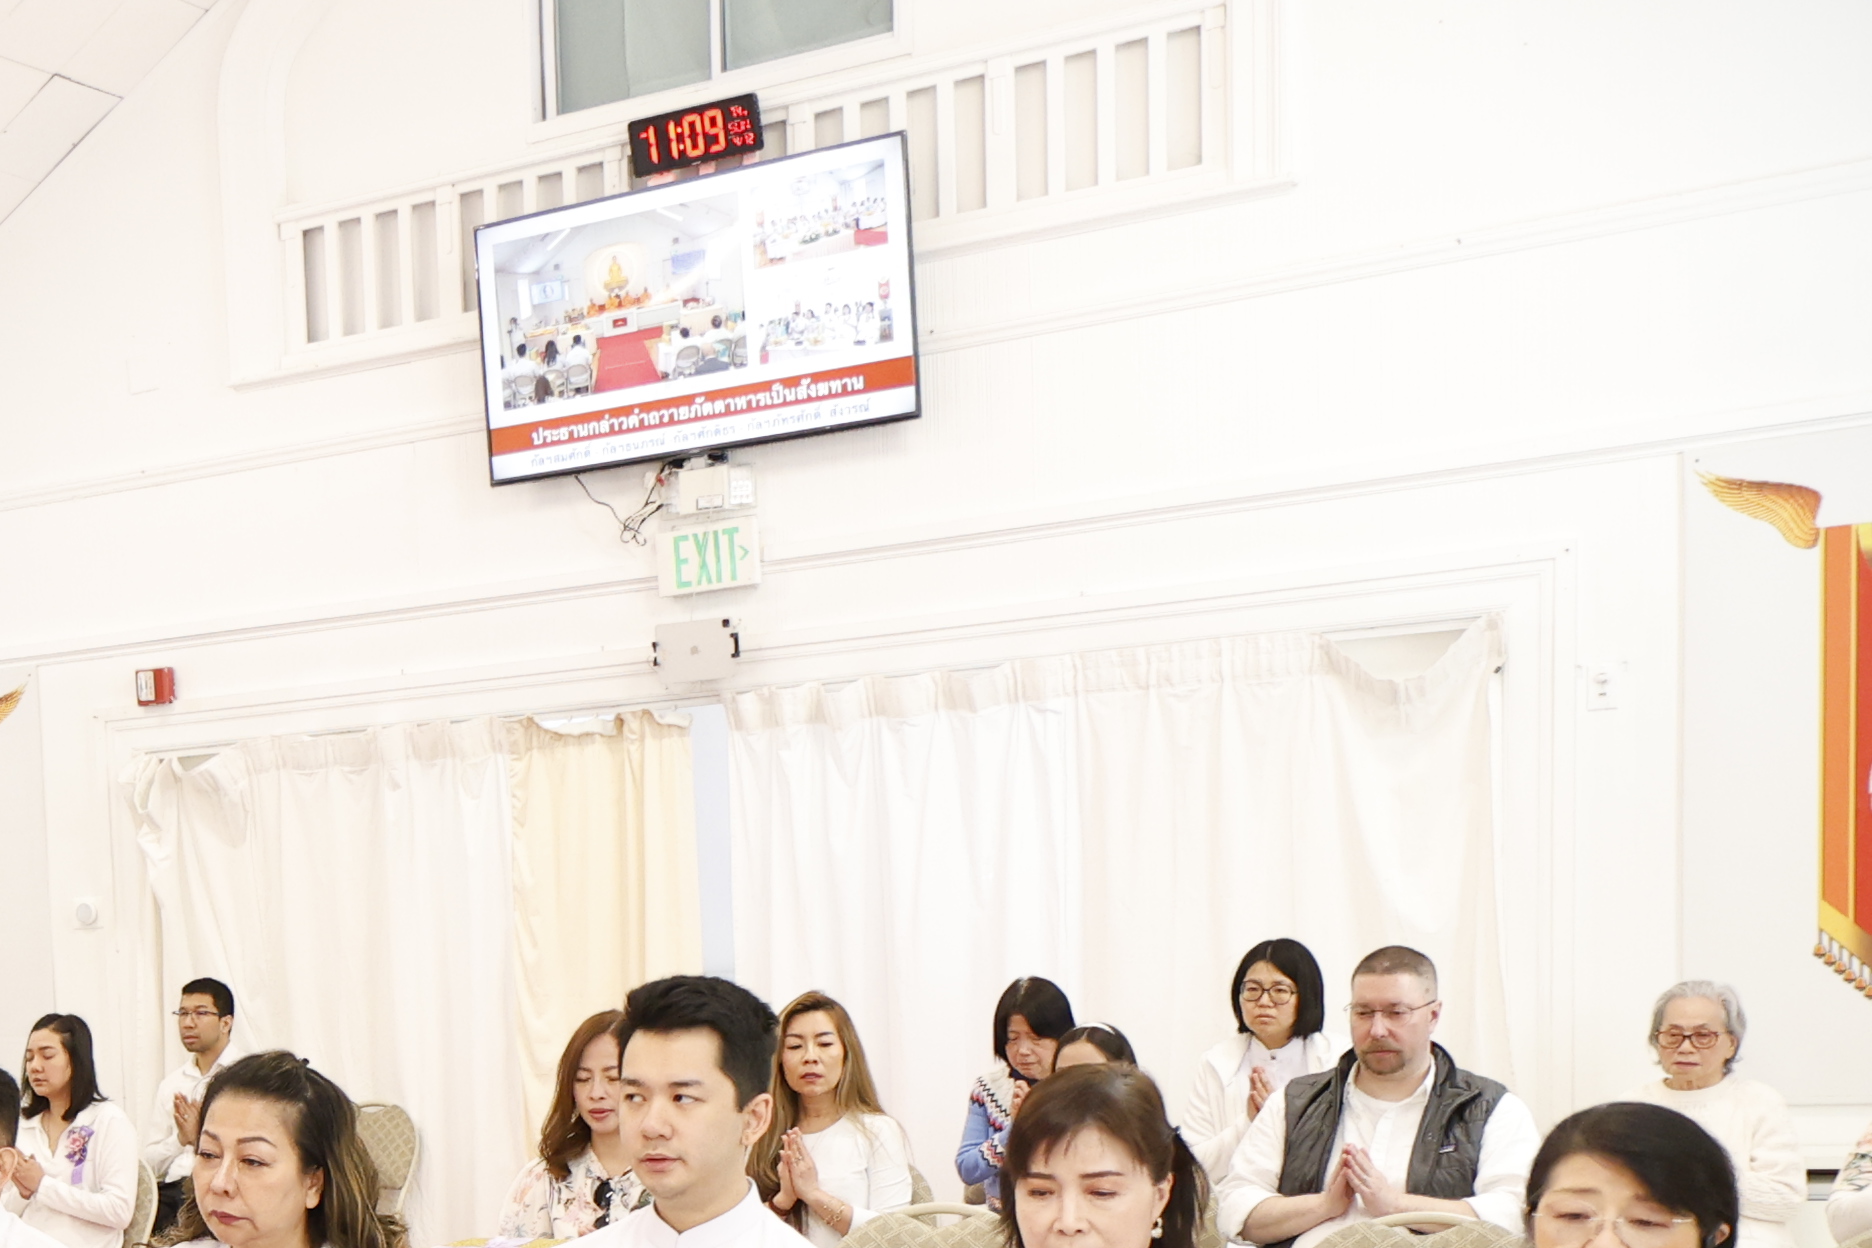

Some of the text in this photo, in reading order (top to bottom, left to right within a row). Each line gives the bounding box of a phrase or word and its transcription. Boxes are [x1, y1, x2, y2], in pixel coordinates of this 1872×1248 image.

[638, 108, 726, 164] 11:09
[531, 374, 865, 446] ประธานกล่าวคำถวายภัตตาหารเป็นสังฆทาน
[673, 526, 739, 589] EXIT
